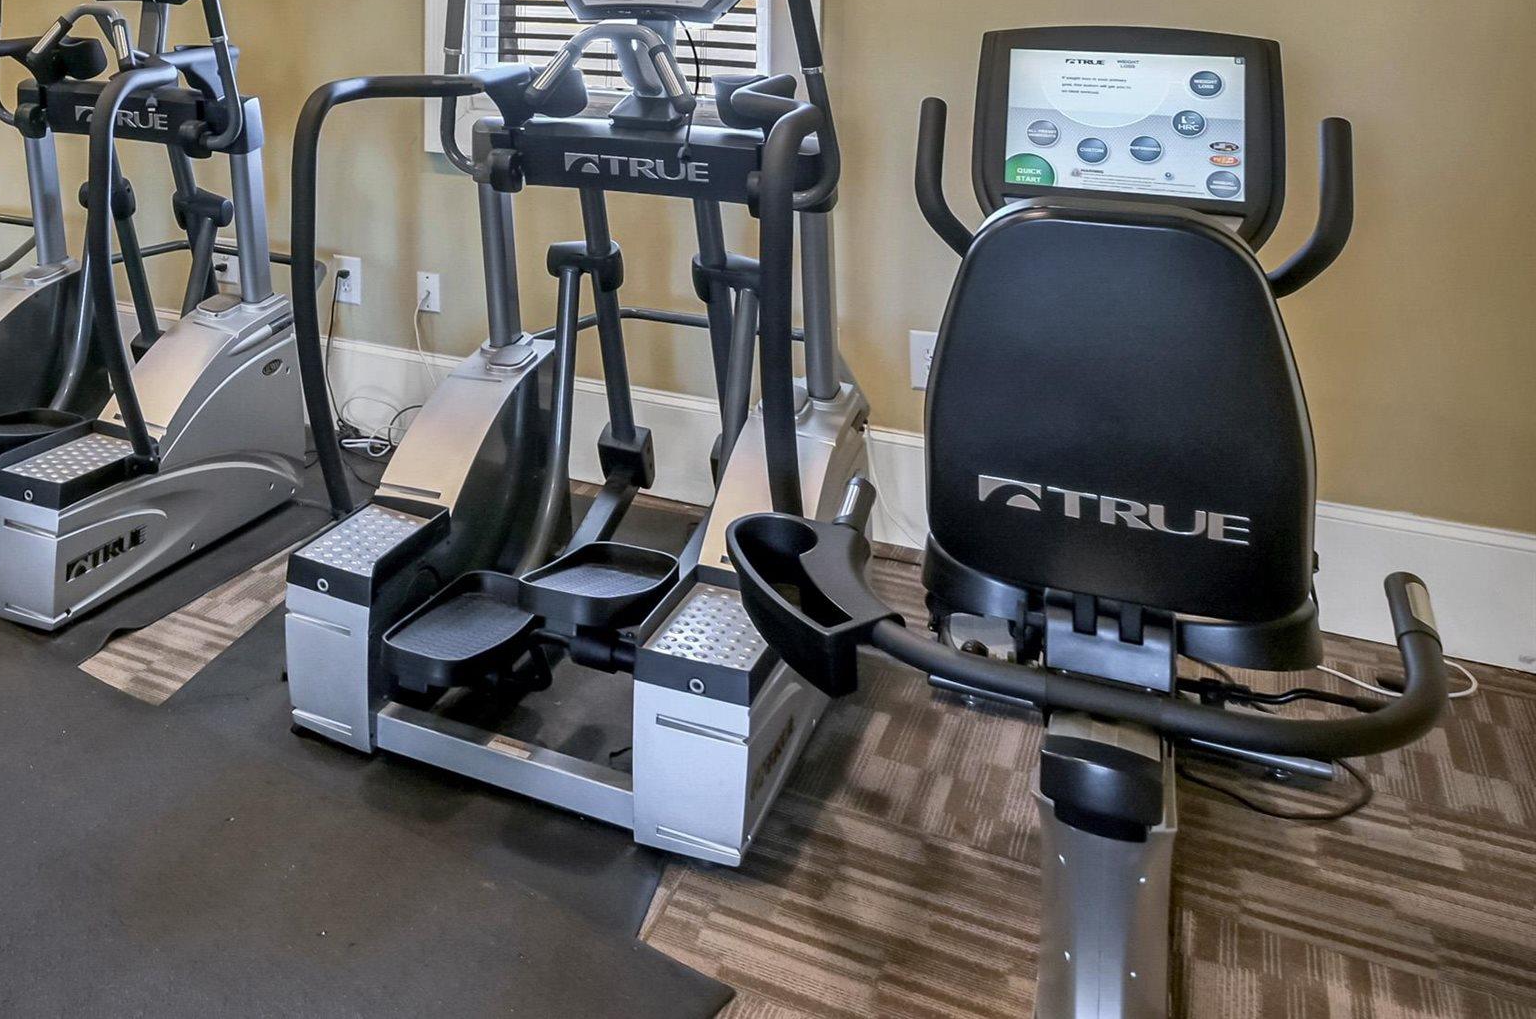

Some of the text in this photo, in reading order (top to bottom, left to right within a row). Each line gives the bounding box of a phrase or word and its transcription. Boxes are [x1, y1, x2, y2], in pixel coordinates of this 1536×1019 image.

[116, 109, 168, 131] RUE
[1177, 123, 1200, 131] HRC
[600, 154, 710, 183] TRUE
[1015, 175, 1041, 183] START
[1016, 167, 1042, 175] QUICK
[1046, 486, 1250, 545] TRUE
[87, 524, 148, 569] TRUE
